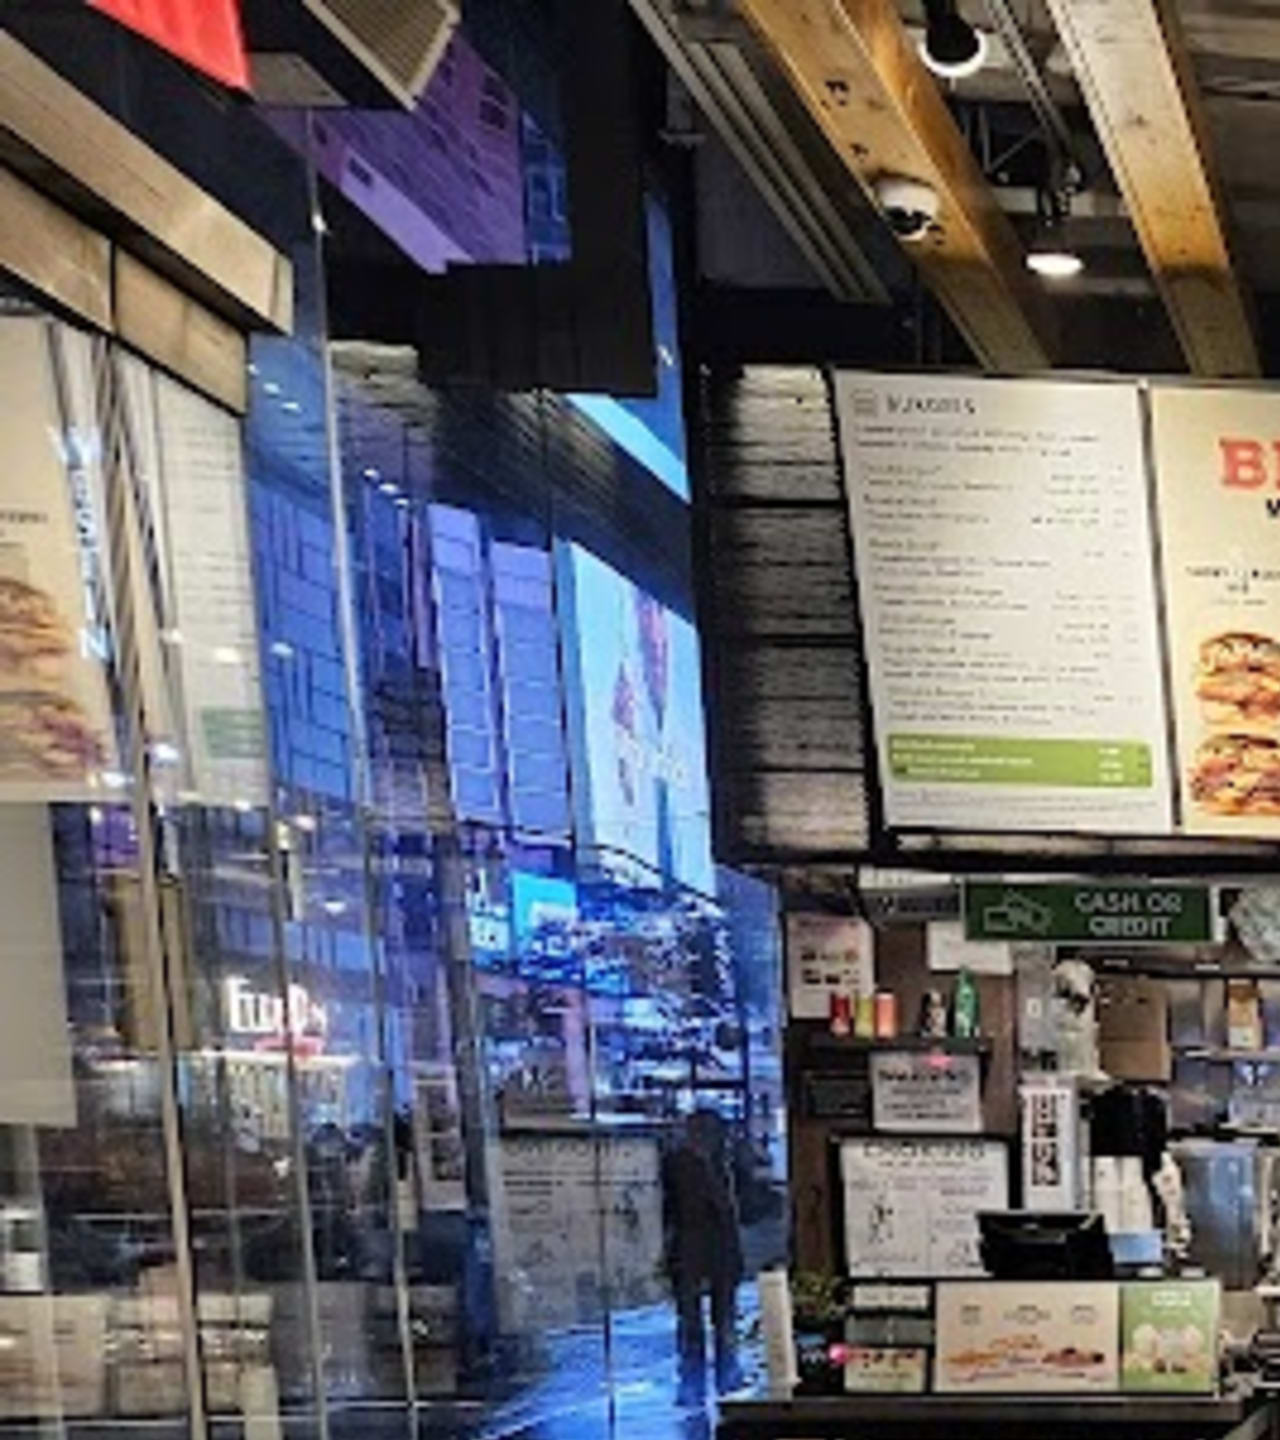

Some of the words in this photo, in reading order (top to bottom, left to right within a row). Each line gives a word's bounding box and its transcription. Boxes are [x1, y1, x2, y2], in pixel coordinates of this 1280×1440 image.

[1074, 893, 1140, 912] CASH
[1146, 893, 1182, 913] OR
[1088, 917, 1172, 937] CREDIT
